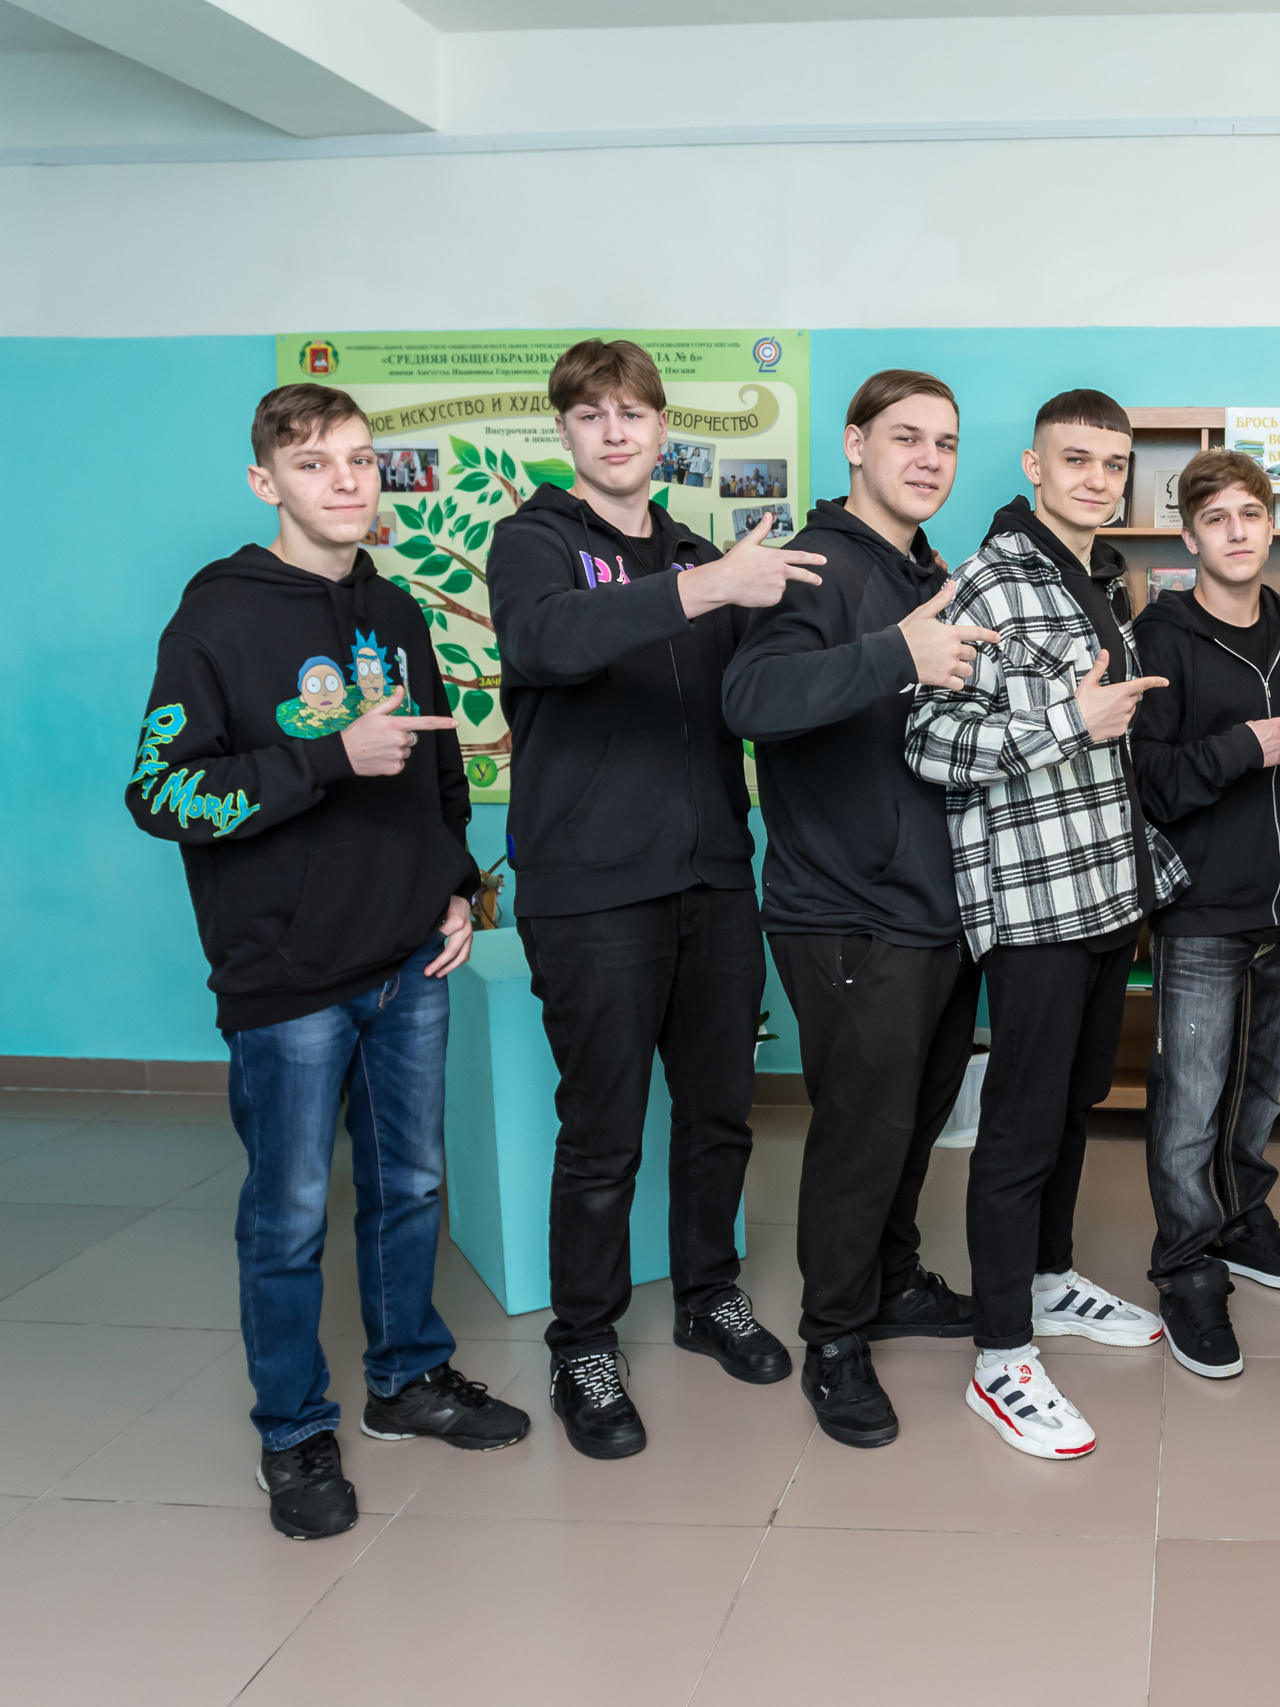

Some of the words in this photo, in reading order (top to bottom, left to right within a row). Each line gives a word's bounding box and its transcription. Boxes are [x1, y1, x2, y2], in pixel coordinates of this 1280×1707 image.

[381, 352, 447, 365] «СРЕДНЯЯ
[450, 352, 561, 365] ОБЩЕОБРАЗОВАТ
[673, 351, 687, 362] №
[689, 351, 703, 362] 6»
[416, 369, 450, 377] Августы
[452, 368, 494, 376] Ивановны
[399, 397, 486, 428] ИСКУССТВО
[491, 396, 502, 412] И
[509, 395, 557, 412] ХУДО
[665, 410, 759, 432] ТВОРЧЕСТВО
[1235, 416, 1279, 428] БРОСЬ
[484, 426, 537, 436] Внеурочная
